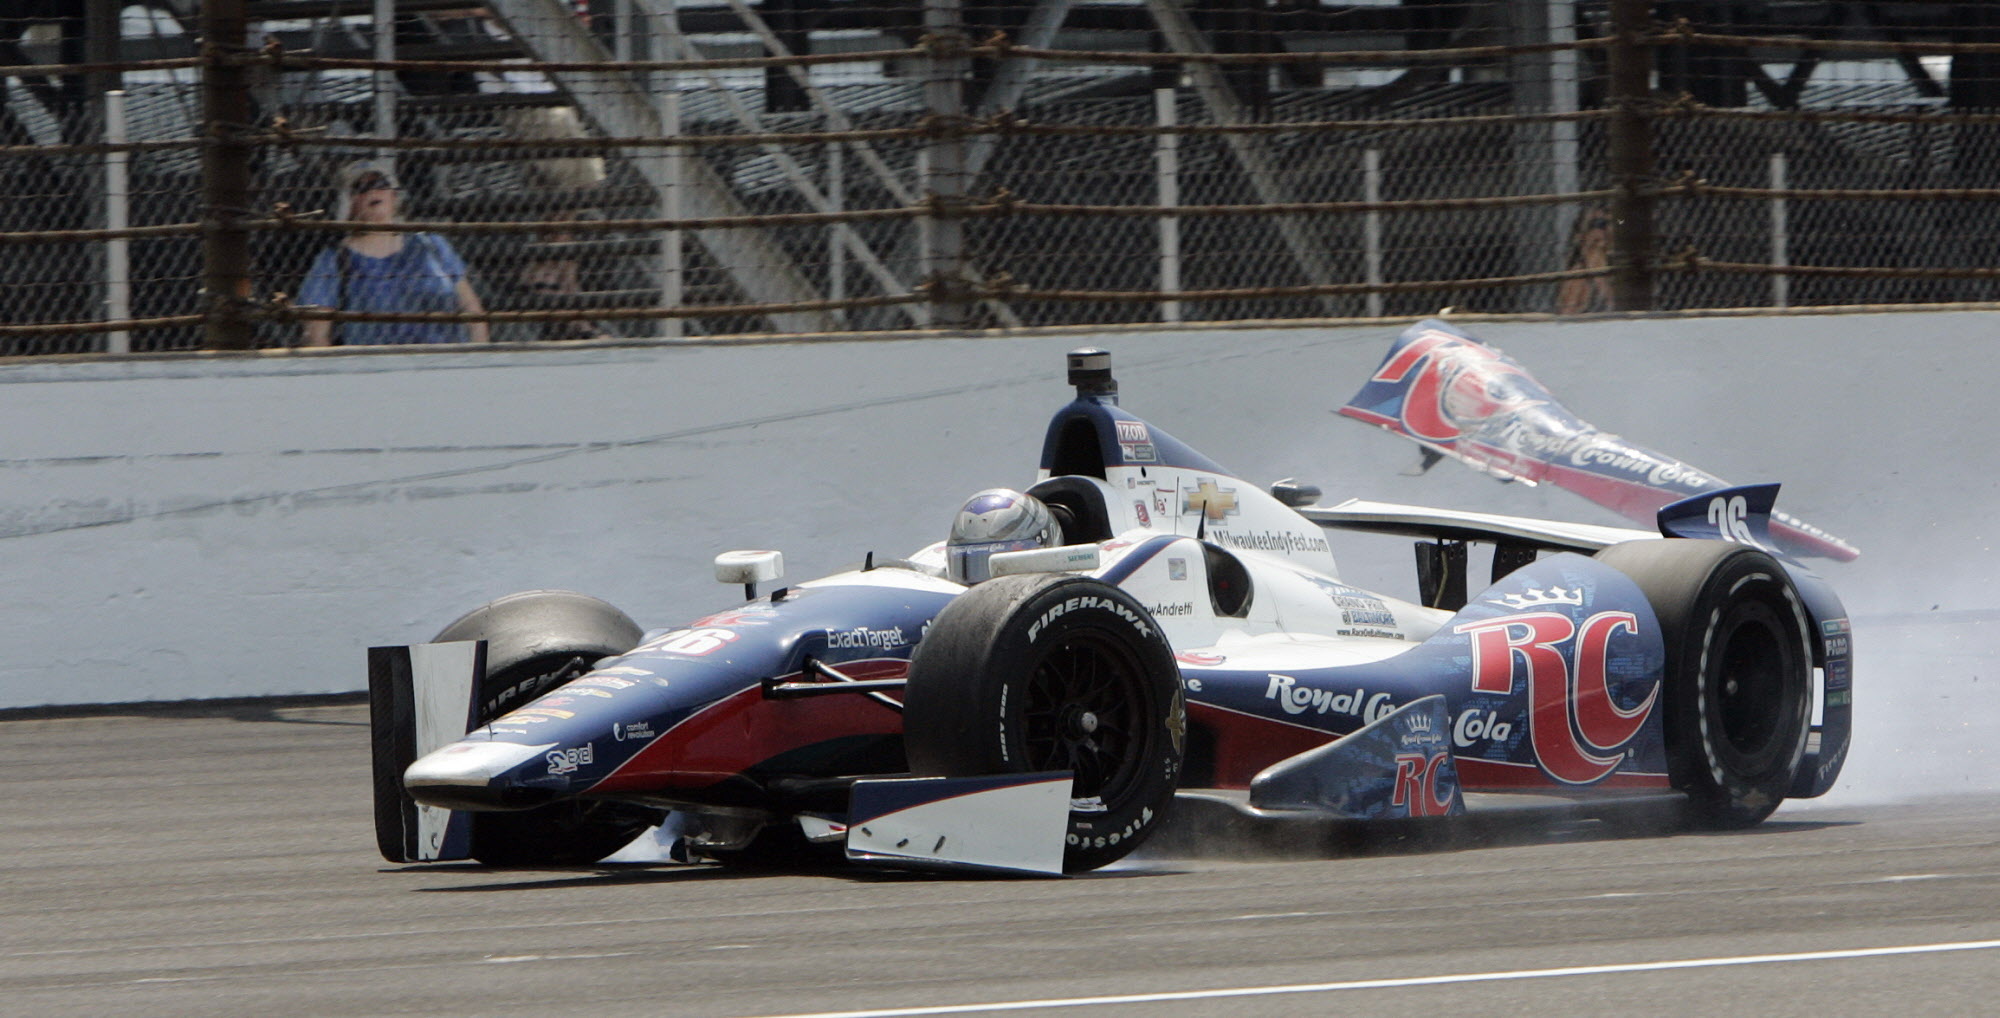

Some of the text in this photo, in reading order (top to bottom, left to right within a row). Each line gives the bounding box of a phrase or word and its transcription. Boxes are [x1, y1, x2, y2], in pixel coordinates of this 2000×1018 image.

[1117, 424, 1147, 441] IZOD
[1571, 442, 1651, 467] Crown
[1647, 461, 1709, 488] Cola
[1213, 529, 1329, 556] MilwaukeeIndyFest.com
[1707, 494, 1769, 553] 26
[826, 626, 904, 650] ExactTarget
[1027, 596, 1152, 644] FIREHAWK
[1351, 611, 1397, 628] BALTIMORE
[1265, 673, 1364, 715] Royal
[1453, 610, 1661, 785] RC
[1453, 708, 1512, 747] Cola
[1391, 751, 1455, 817] RC
[1066, 806, 1153, 850] Firesto
